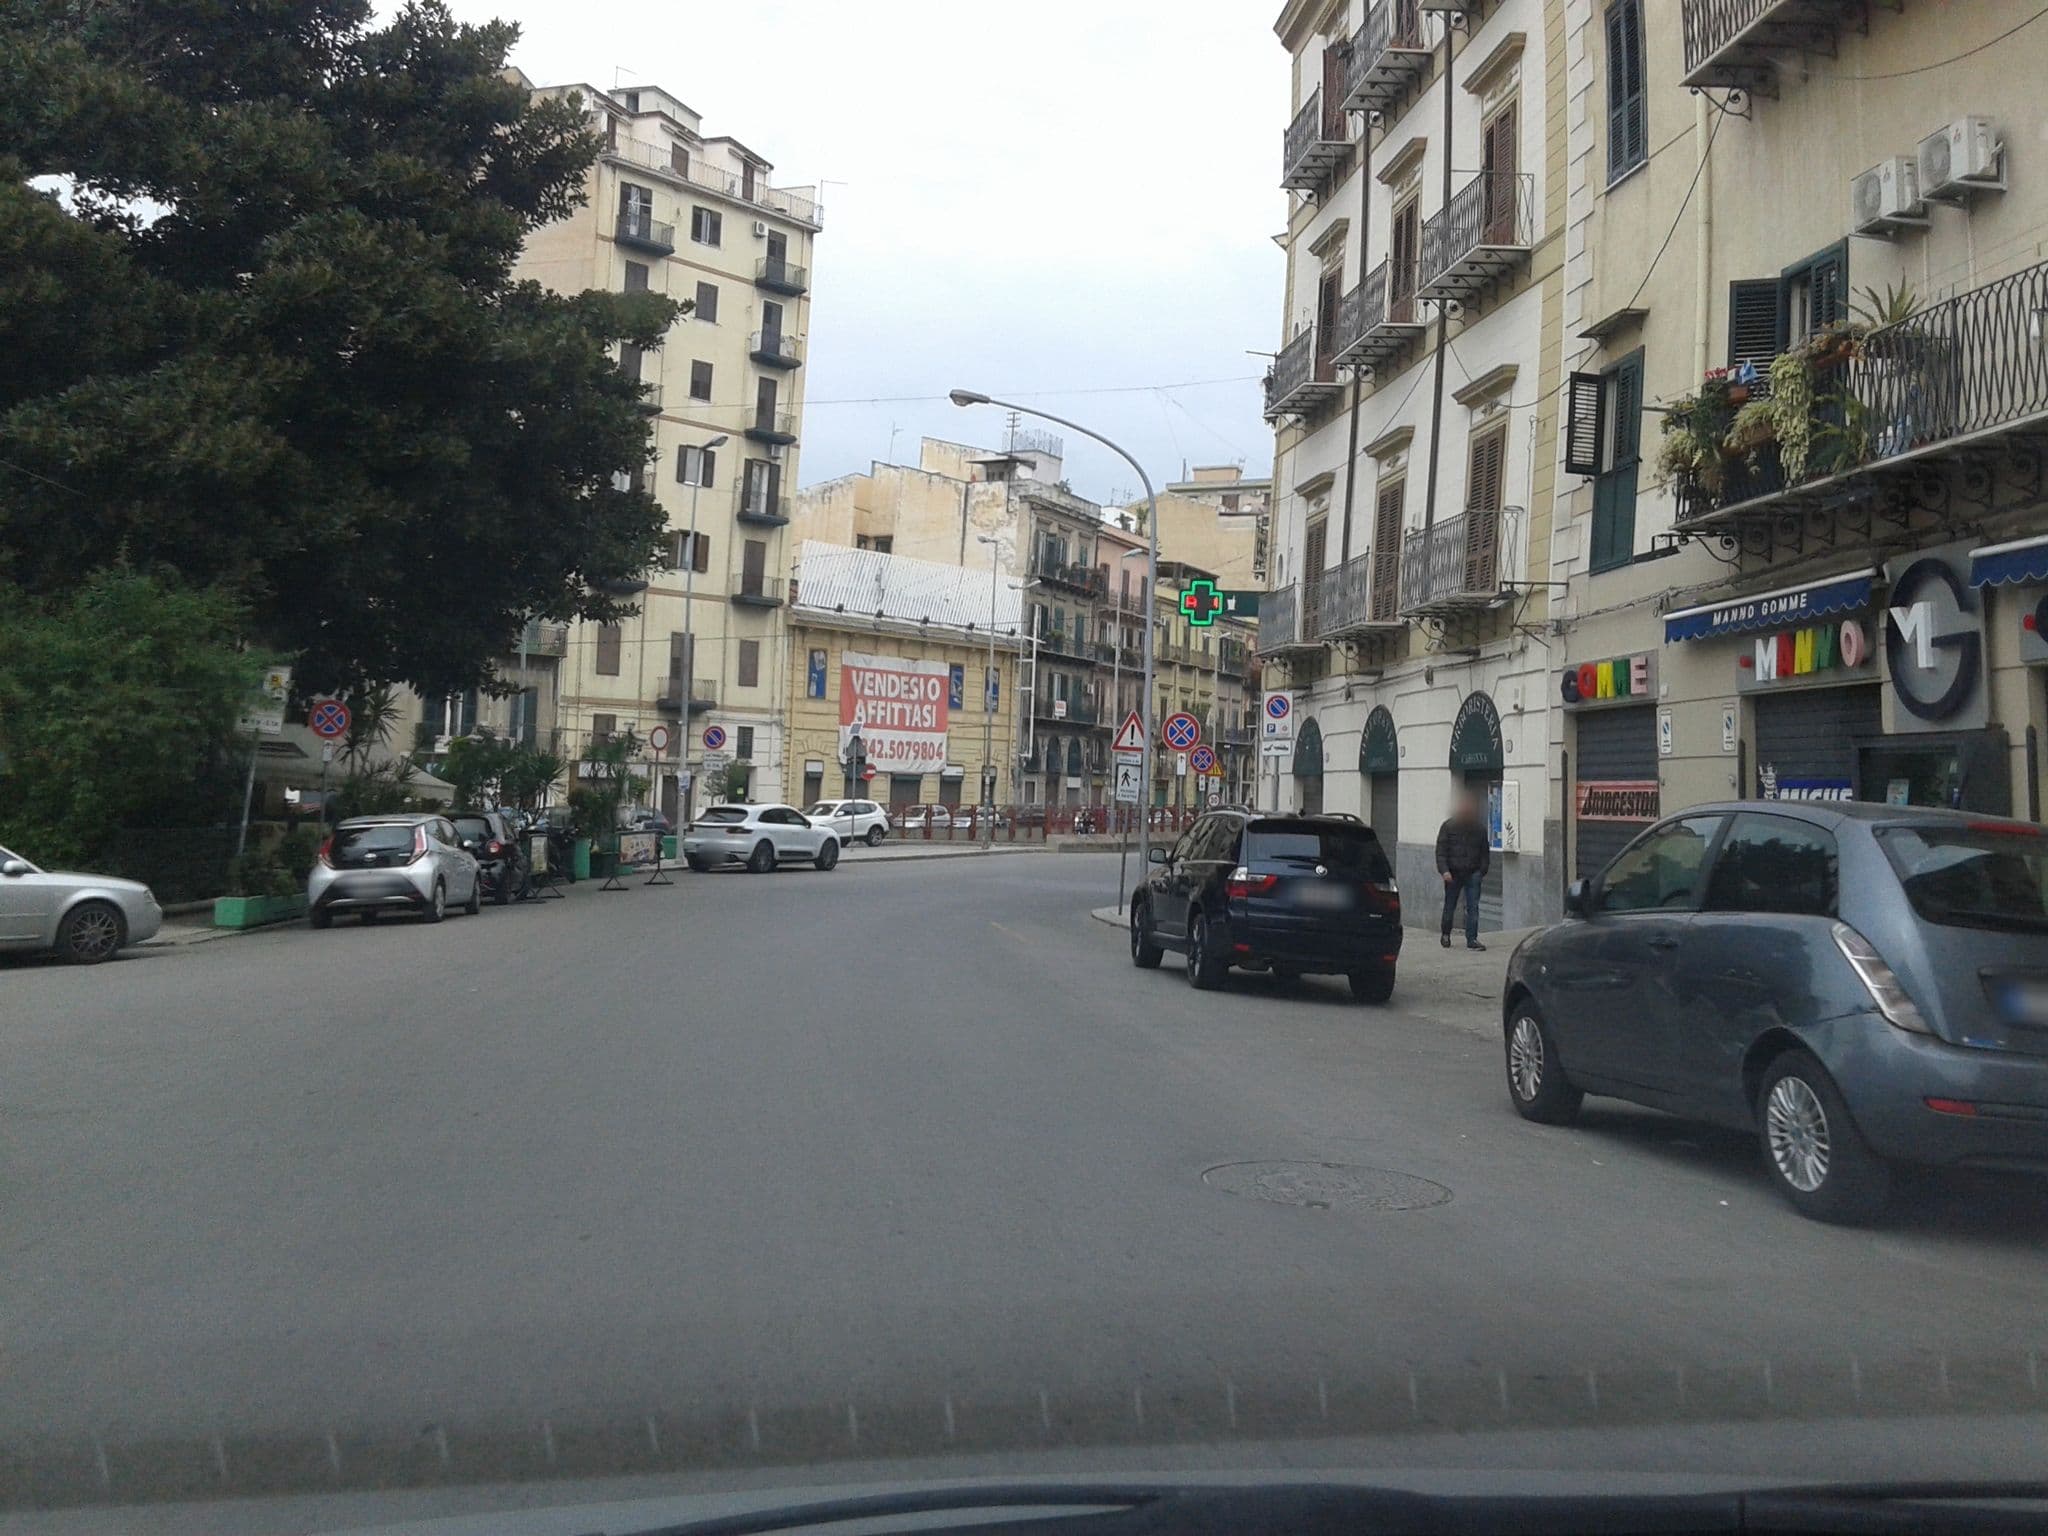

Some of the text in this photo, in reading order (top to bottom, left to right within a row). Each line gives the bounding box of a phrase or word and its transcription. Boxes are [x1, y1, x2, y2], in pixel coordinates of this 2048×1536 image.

[1712, 592, 1808, 626] MANNO GOMME
[1755, 619, 1866, 682] MANNO
[851, 669, 941, 701] VENDESI O
[1561, 655, 1649, 704] GOMME
[854, 699, 937, 728] AFFITTASI
